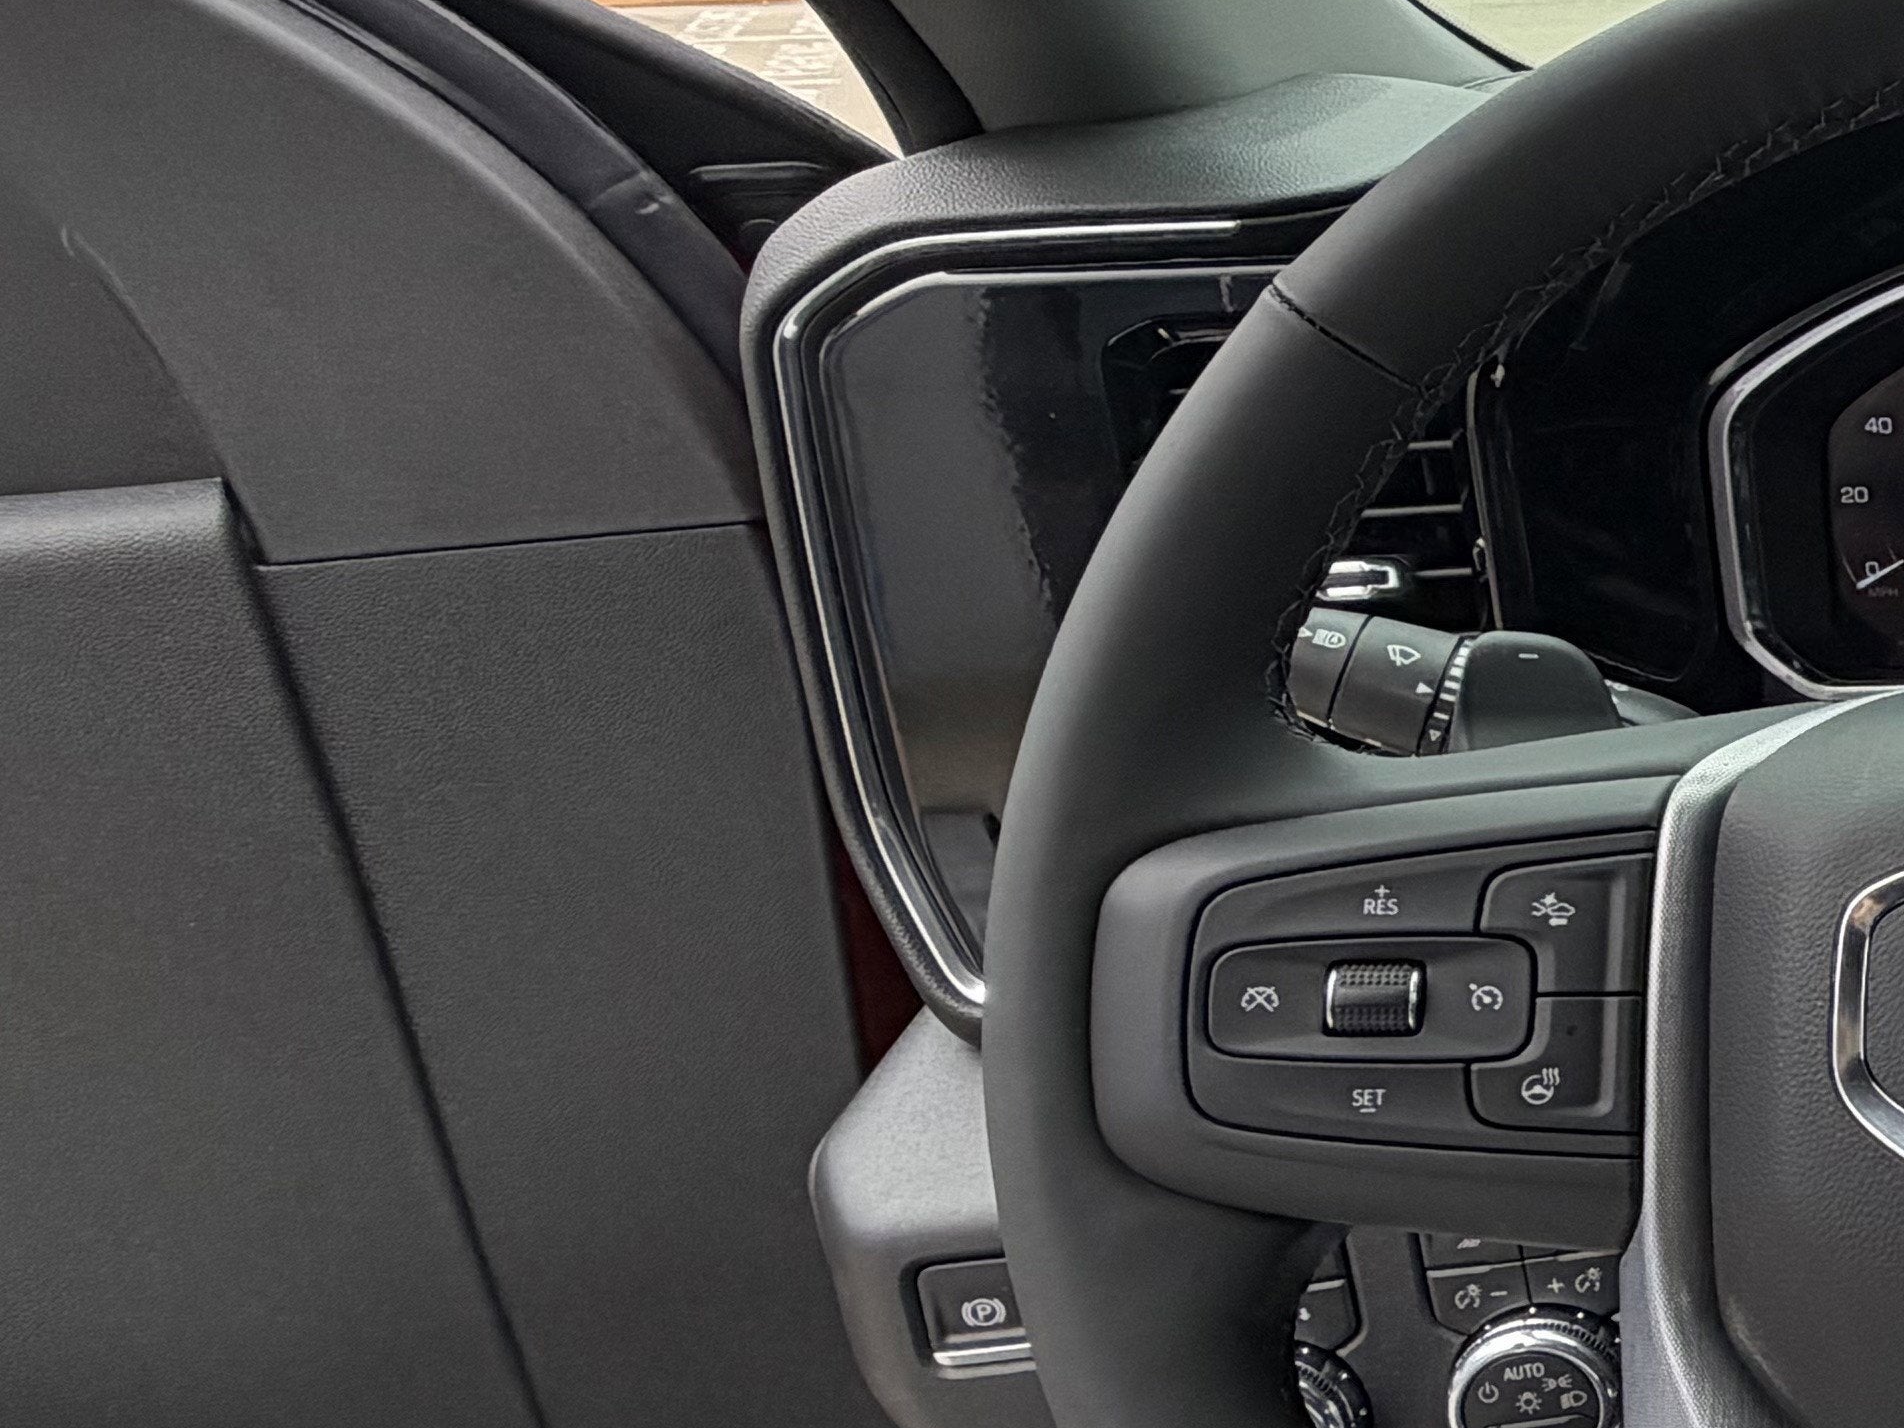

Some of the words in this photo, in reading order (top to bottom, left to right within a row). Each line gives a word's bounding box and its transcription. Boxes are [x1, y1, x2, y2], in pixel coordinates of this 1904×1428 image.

[1864, 417, 1893, 434] 40
[1840, 486, 1869, 504] 20
[1864, 560, 1880, 578] 0
[1362, 897, 1400, 916] RES
[1351, 1088, 1387, 1108] SET
[1503, 1361, 1546, 1382] AUTO
